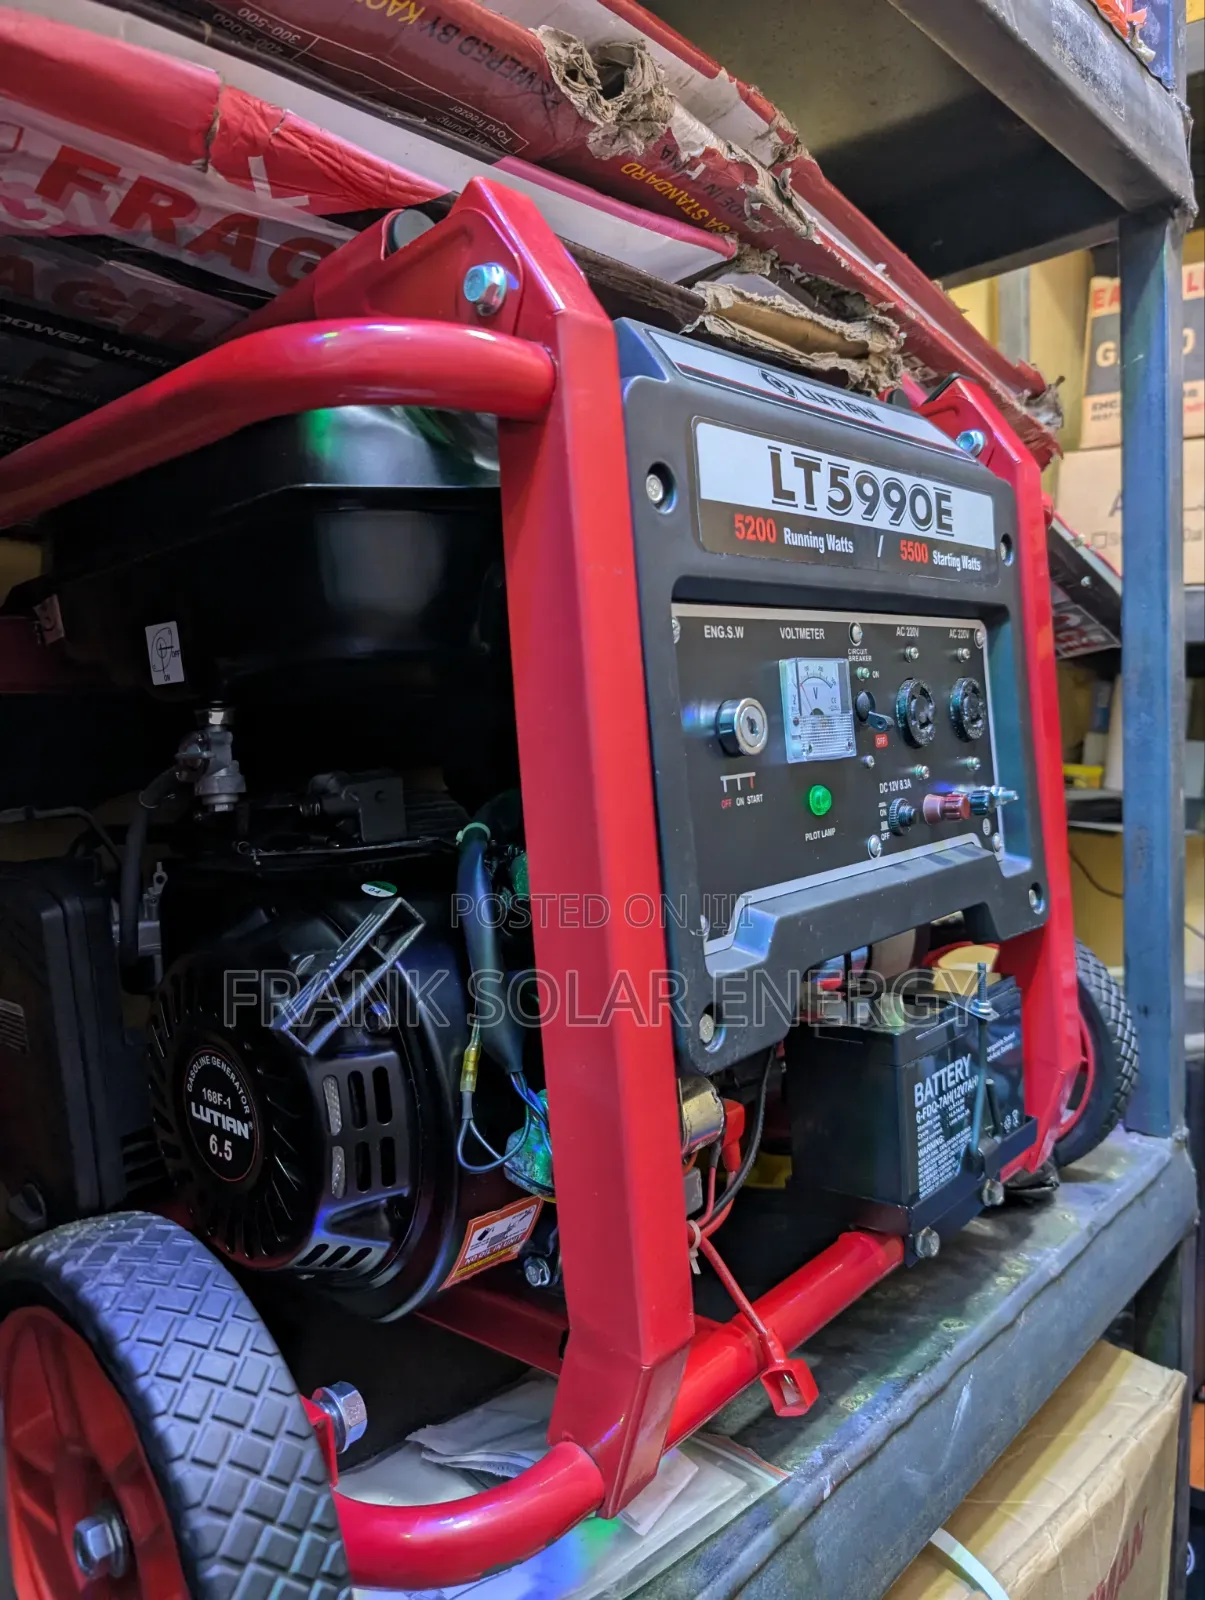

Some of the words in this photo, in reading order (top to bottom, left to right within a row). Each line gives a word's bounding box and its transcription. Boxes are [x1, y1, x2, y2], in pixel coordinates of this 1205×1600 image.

[420, 17, 460, 46] BY
[621, 162, 710, 222] STANDARD
[702, 183, 724, 201] IN
[718, 196, 747, 222] ADE
[704, 217, 732, 236] SA
[799, 386, 883, 423] LUTIAN
[768, 446, 954, 537] LT5990E
[733, 513, 777, 545] 5200
[783, 528, 825, 555] Running
[826, 533, 854, 554] Watts
[900, 540, 928, 564] 5500
[932, 551, 961, 572] Starting
[961, 555, 981, 572] Watts
[704, 625, 745, 639] ENG.S.W
[779, 627, 825, 640] VOLTMETER
[896, 628, 905, 637] AC
[906, 628, 919, 638] 220V
[949, 629, 957, 639] AC
[958, 629, 970, 639] 220V
[164, 674, 171, 682] ON
[872, 671, 880, 679] ON
[813, 687, 818, 700] V
[877, 736, 887, 746] OFF
[879, 783, 888, 793] DC
[888, 782, 899, 792] 12V
[899, 779, 912, 790] 8.3A
[721, 798, 732, 808] OFF
[736, 796, 745, 806] ON
[746, 794, 764, 805] START
[805, 830, 820, 841] PILOT
[820, 828, 836, 839] LAMP
[881, 832, 891, 840] OFF
[187, 1055, 211, 1092] GASOLINE
[210, 1055, 250, 1115] GENERATOR
[914, 1053, 971, 1108] BATTERY
[202, 1086, 233, 1110] 168F-1
[190, 1101, 250, 1139] LUTIAN
[209, 1133, 233, 1162] 6.5
